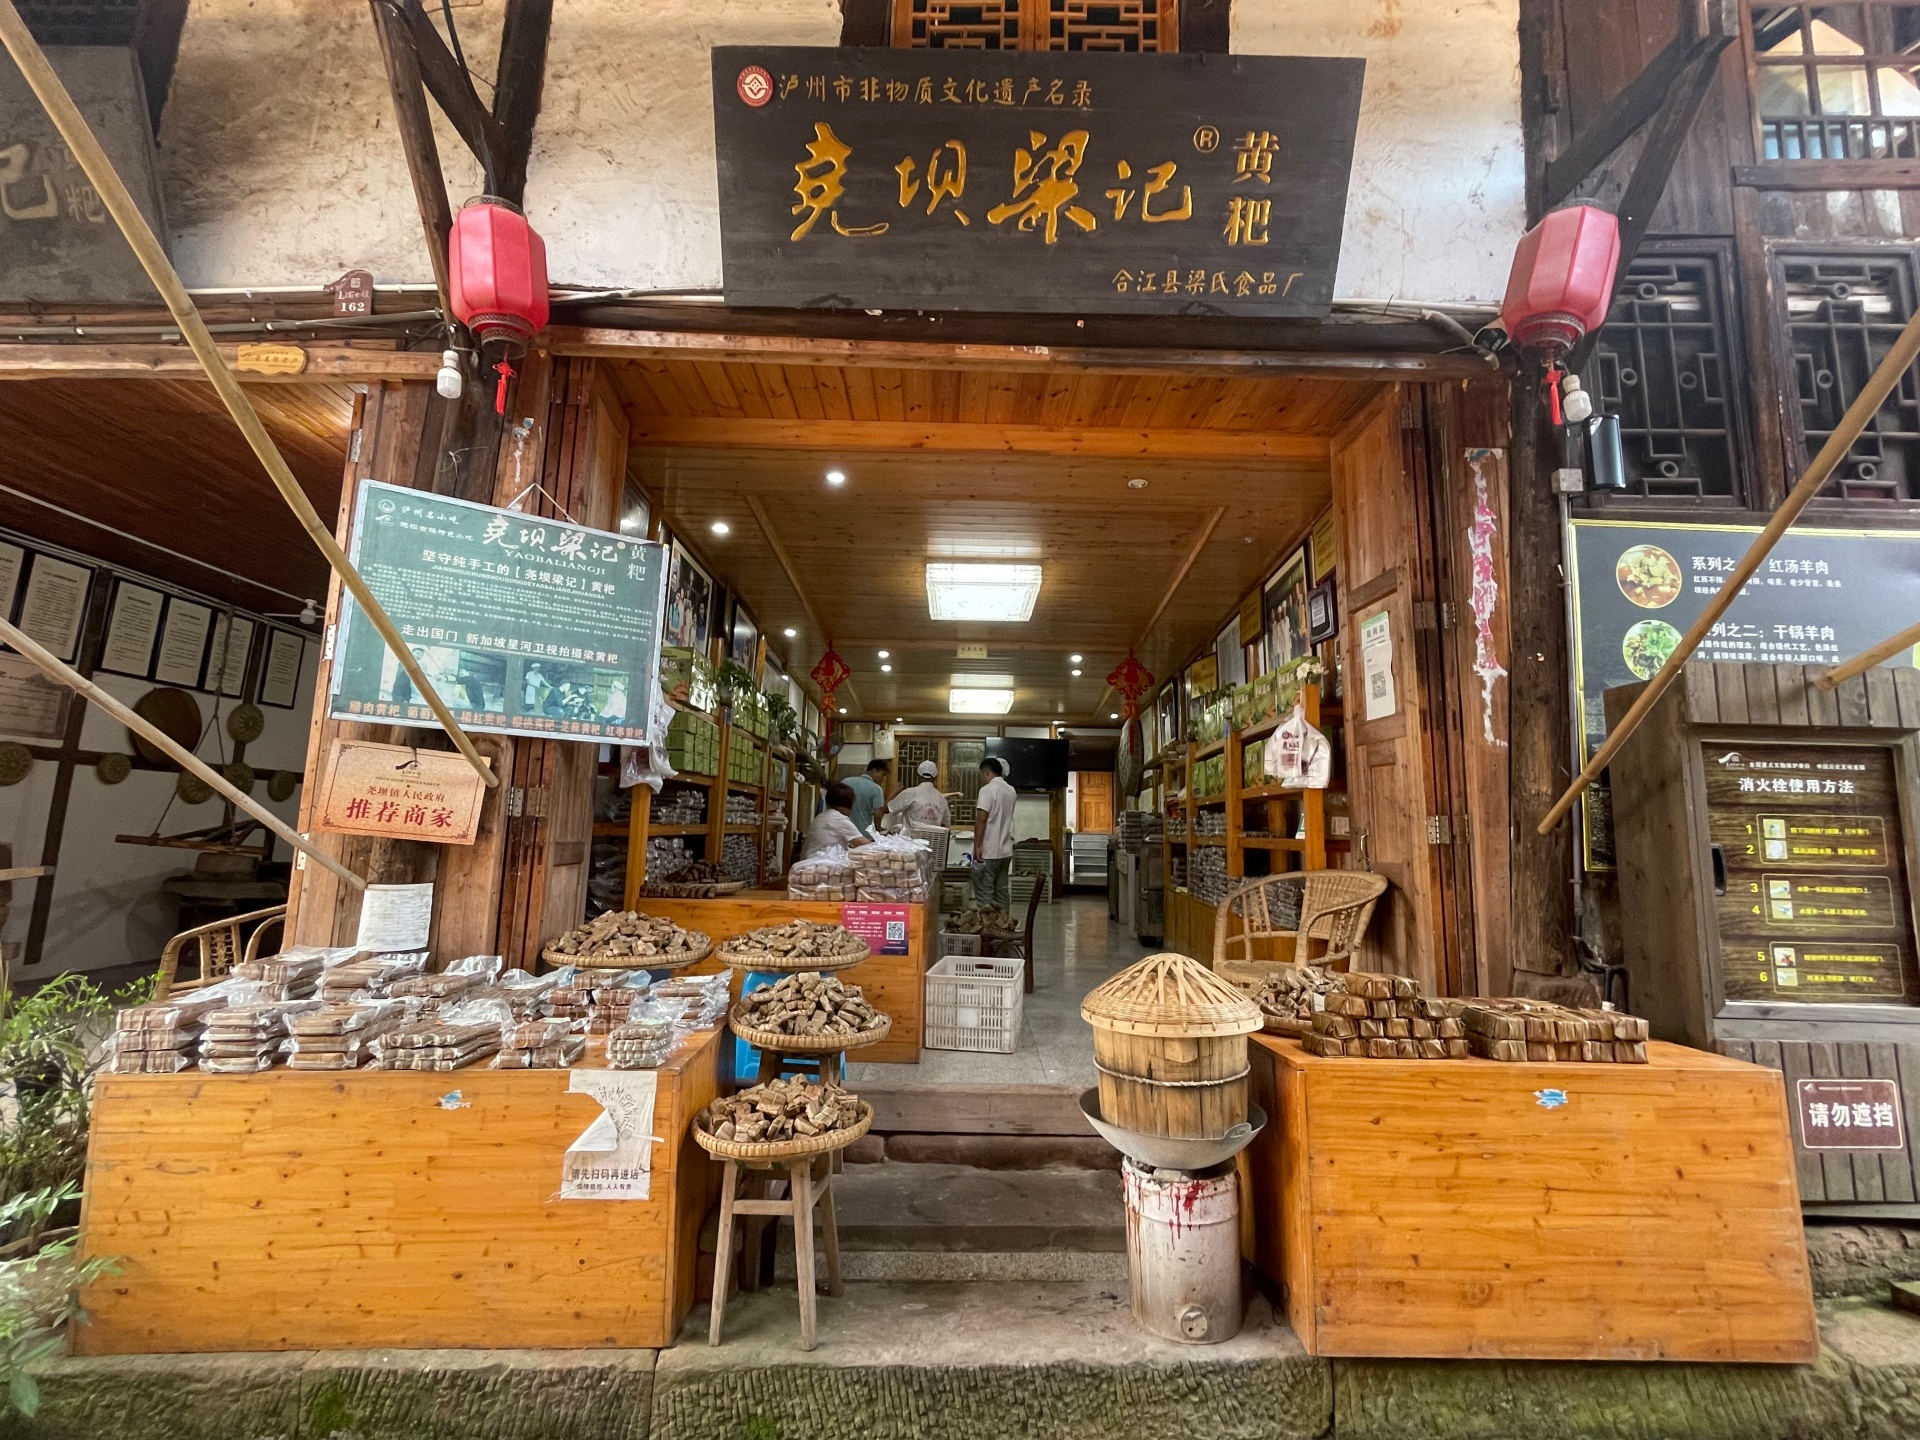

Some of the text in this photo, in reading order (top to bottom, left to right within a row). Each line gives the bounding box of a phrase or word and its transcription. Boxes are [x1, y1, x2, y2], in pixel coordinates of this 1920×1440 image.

[779, 74, 1093, 107] 泸州市非物质文化遗产名录
[1223, 130, 1281, 246] 黄粑
[1111, 268, 1304, 297] 合江县梁氏食品厂
[340, 301, 365, 312] 162
[401, 505, 460, 525] 泸州名小吃
[504, 549, 606, 576] YAOBALIANGJI
[626, 544, 648, 581] 黄粑
[1691, 557, 1830, 575] 系列之：红汤羊肉
[401, 624, 458, 641] 走出国门
[1706, 622, 1836, 641] 列之二：干锅羊肉
[349, 700, 401, 717] 腊肉黄粑
[407, 706, 456, 720] 葡萄
[561, 720, 601, 735] 芝麻黄粑
[366, 785, 446, 803] 尧坝镇人民政府
[1738, 777, 1855, 794] 消火栓使用方法
[346, 797, 455, 828] 推荐商家
[1745, 824, 1754, 834] 1
[1746, 845, 1755, 854] 2
[1750, 882, 1759, 893] 3
[1752, 905, 1761, 915] 4
[1757, 951, 1766, 961] 5
[1759, 972, 1768, 982] 6
[1808, 1102, 1895, 1127] 请勿遮挡
[571, 1169, 640, 1181] 请先扫码再进店
